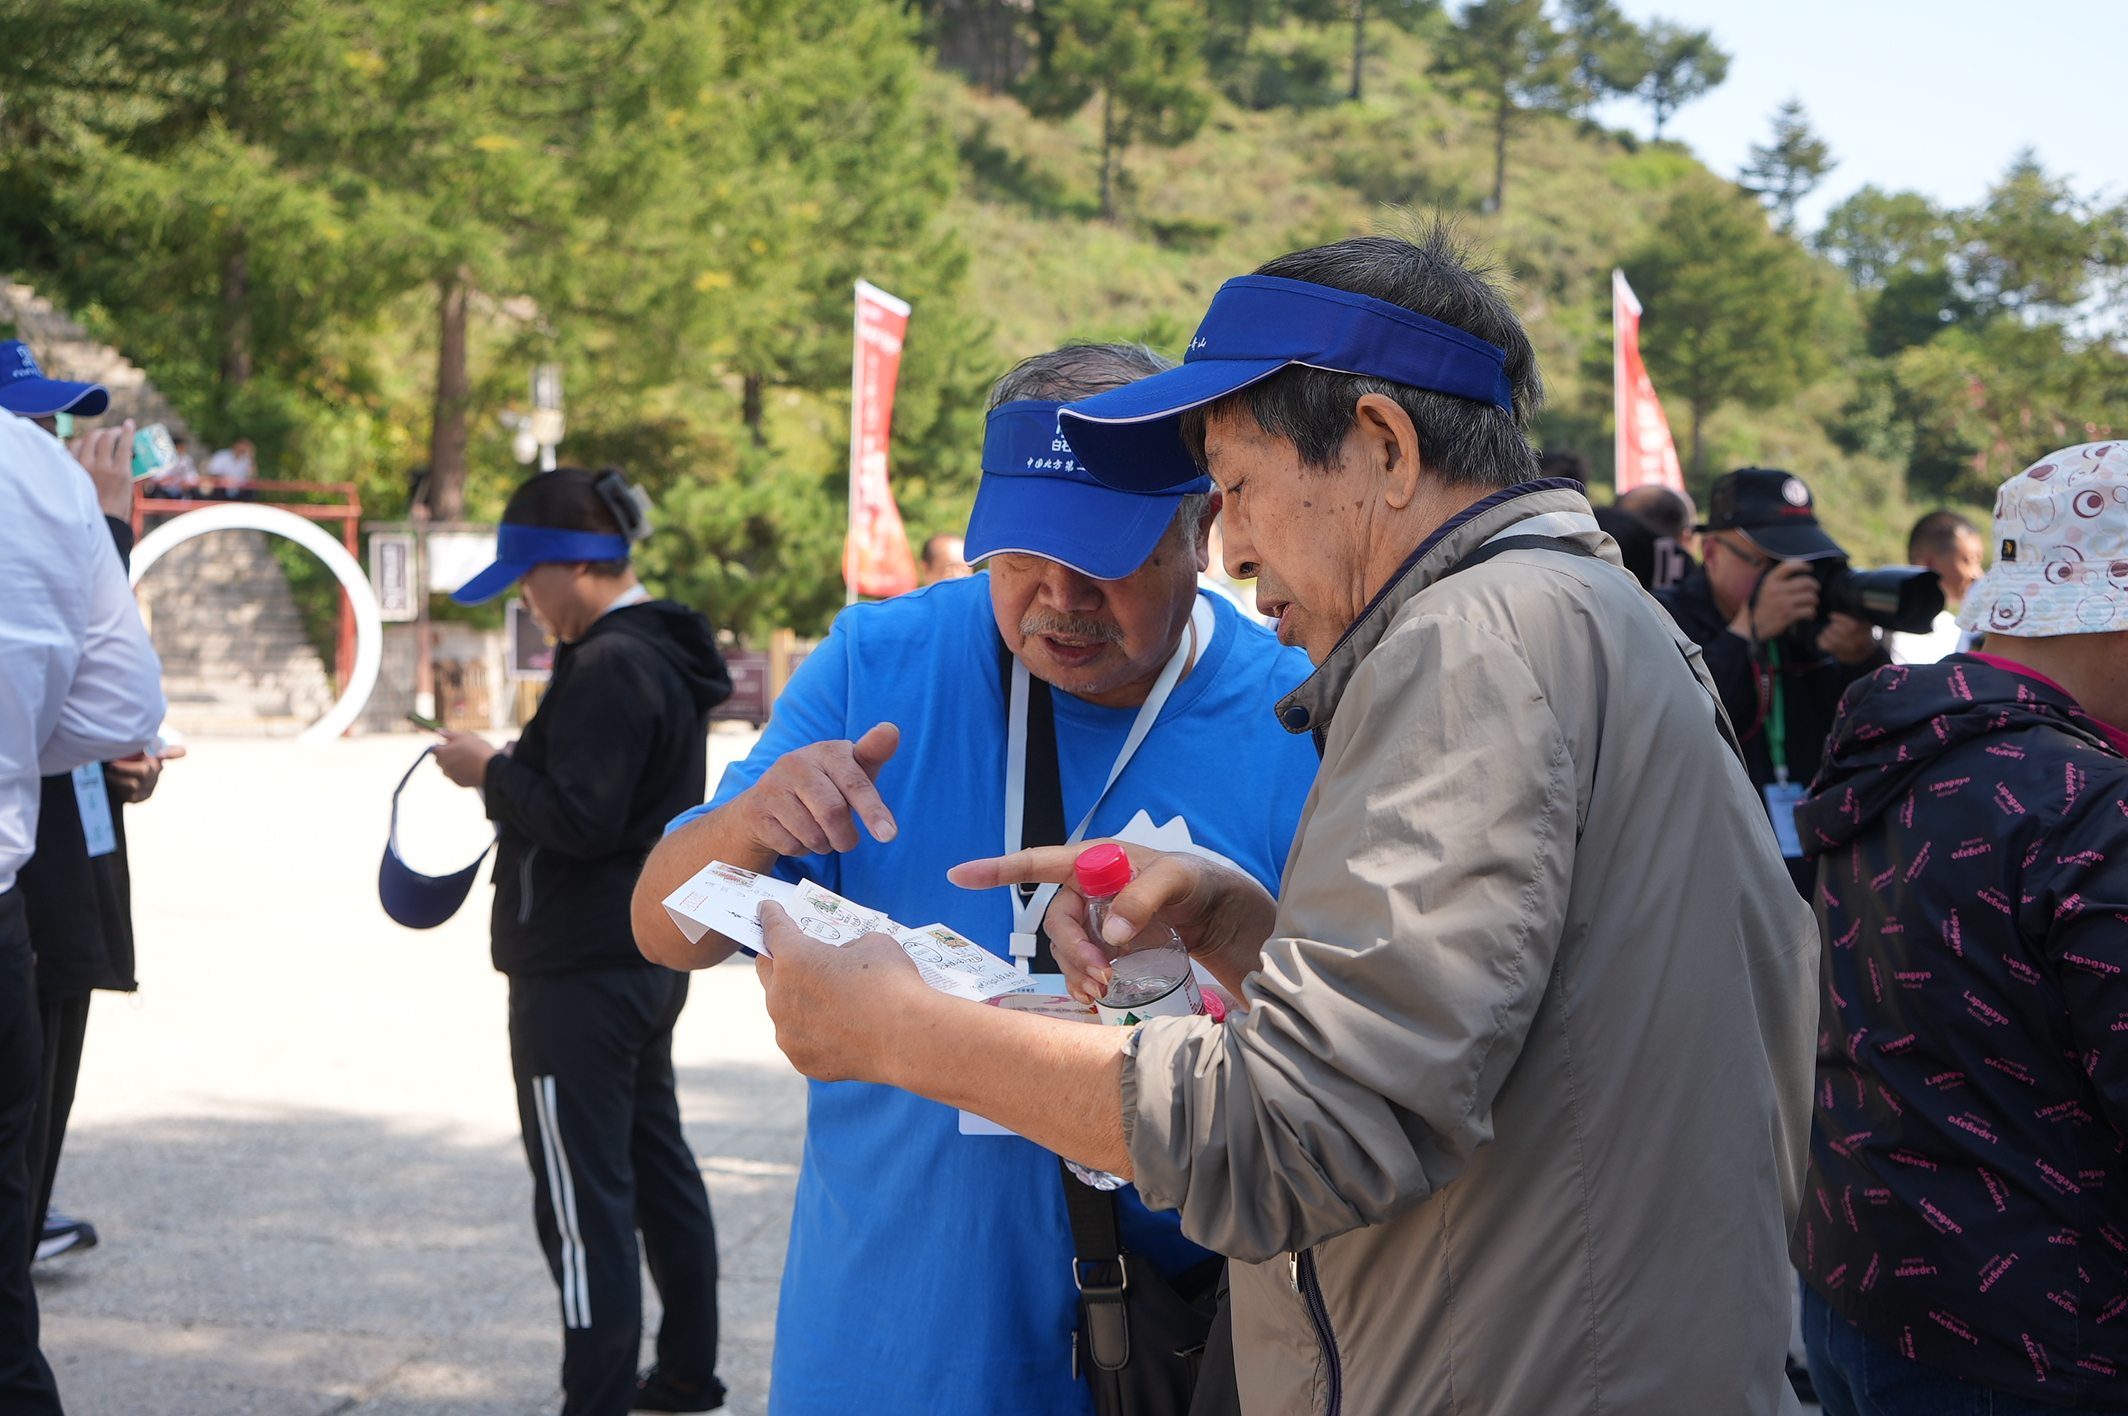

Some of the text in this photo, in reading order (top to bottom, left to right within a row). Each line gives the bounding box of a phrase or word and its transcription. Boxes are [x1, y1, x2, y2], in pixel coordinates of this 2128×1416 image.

[1051, 438, 1073, 453] 白石
[1026, 457, 1087, 473] 中国北方第一
[1929, 776, 1971, 792] Lapagayo
[1951, 843, 1992, 860] Lapagayo
[2053, 892, 2081, 920] pagayo
[1949, 907, 1964, 957] Lapagayo
[1893, 971, 1932, 981] Lapagayo
[2002, 953, 2041, 980] Lapago
[2063, 951, 2122, 974] Lapagayo
[1963, 990, 2010, 1026] Lapagayo
[1966, 1007, 1993, 1027] Holland
[1984, 1057, 2036, 1086] Lapagayo
[2086, 1048, 2101, 1078] Lapag
[1963, 1111, 1992, 1129] Holland
[2034, 1099, 2078, 1119] Lapagay
[1947, 1114, 1999, 1145] Lapagayo
[1889, 1152, 1938, 1172] Lapagayo
[2034, 1157, 2081, 1194] Lapagayo
[1977, 1166, 2007, 1213] Lapagayo
[1919, 1196, 1963, 1234] Lapagayo
[2047, 1234, 2079, 1247] agayo
[1894, 1265, 1938, 1277] Lapagayo
[1979, 1252, 2020, 1293] Lapagayo
[2046, 1291, 2079, 1317] agayo
[2096, 1296, 2128, 1325] apagayo
[1929, 1311, 1979, 1346] Lapagayo
[1904, 1325, 1917, 1361] Lapag
[2021, 1332, 2047, 1383] Lapagayo
[2077, 1359, 2117, 1377] Lapagayo
